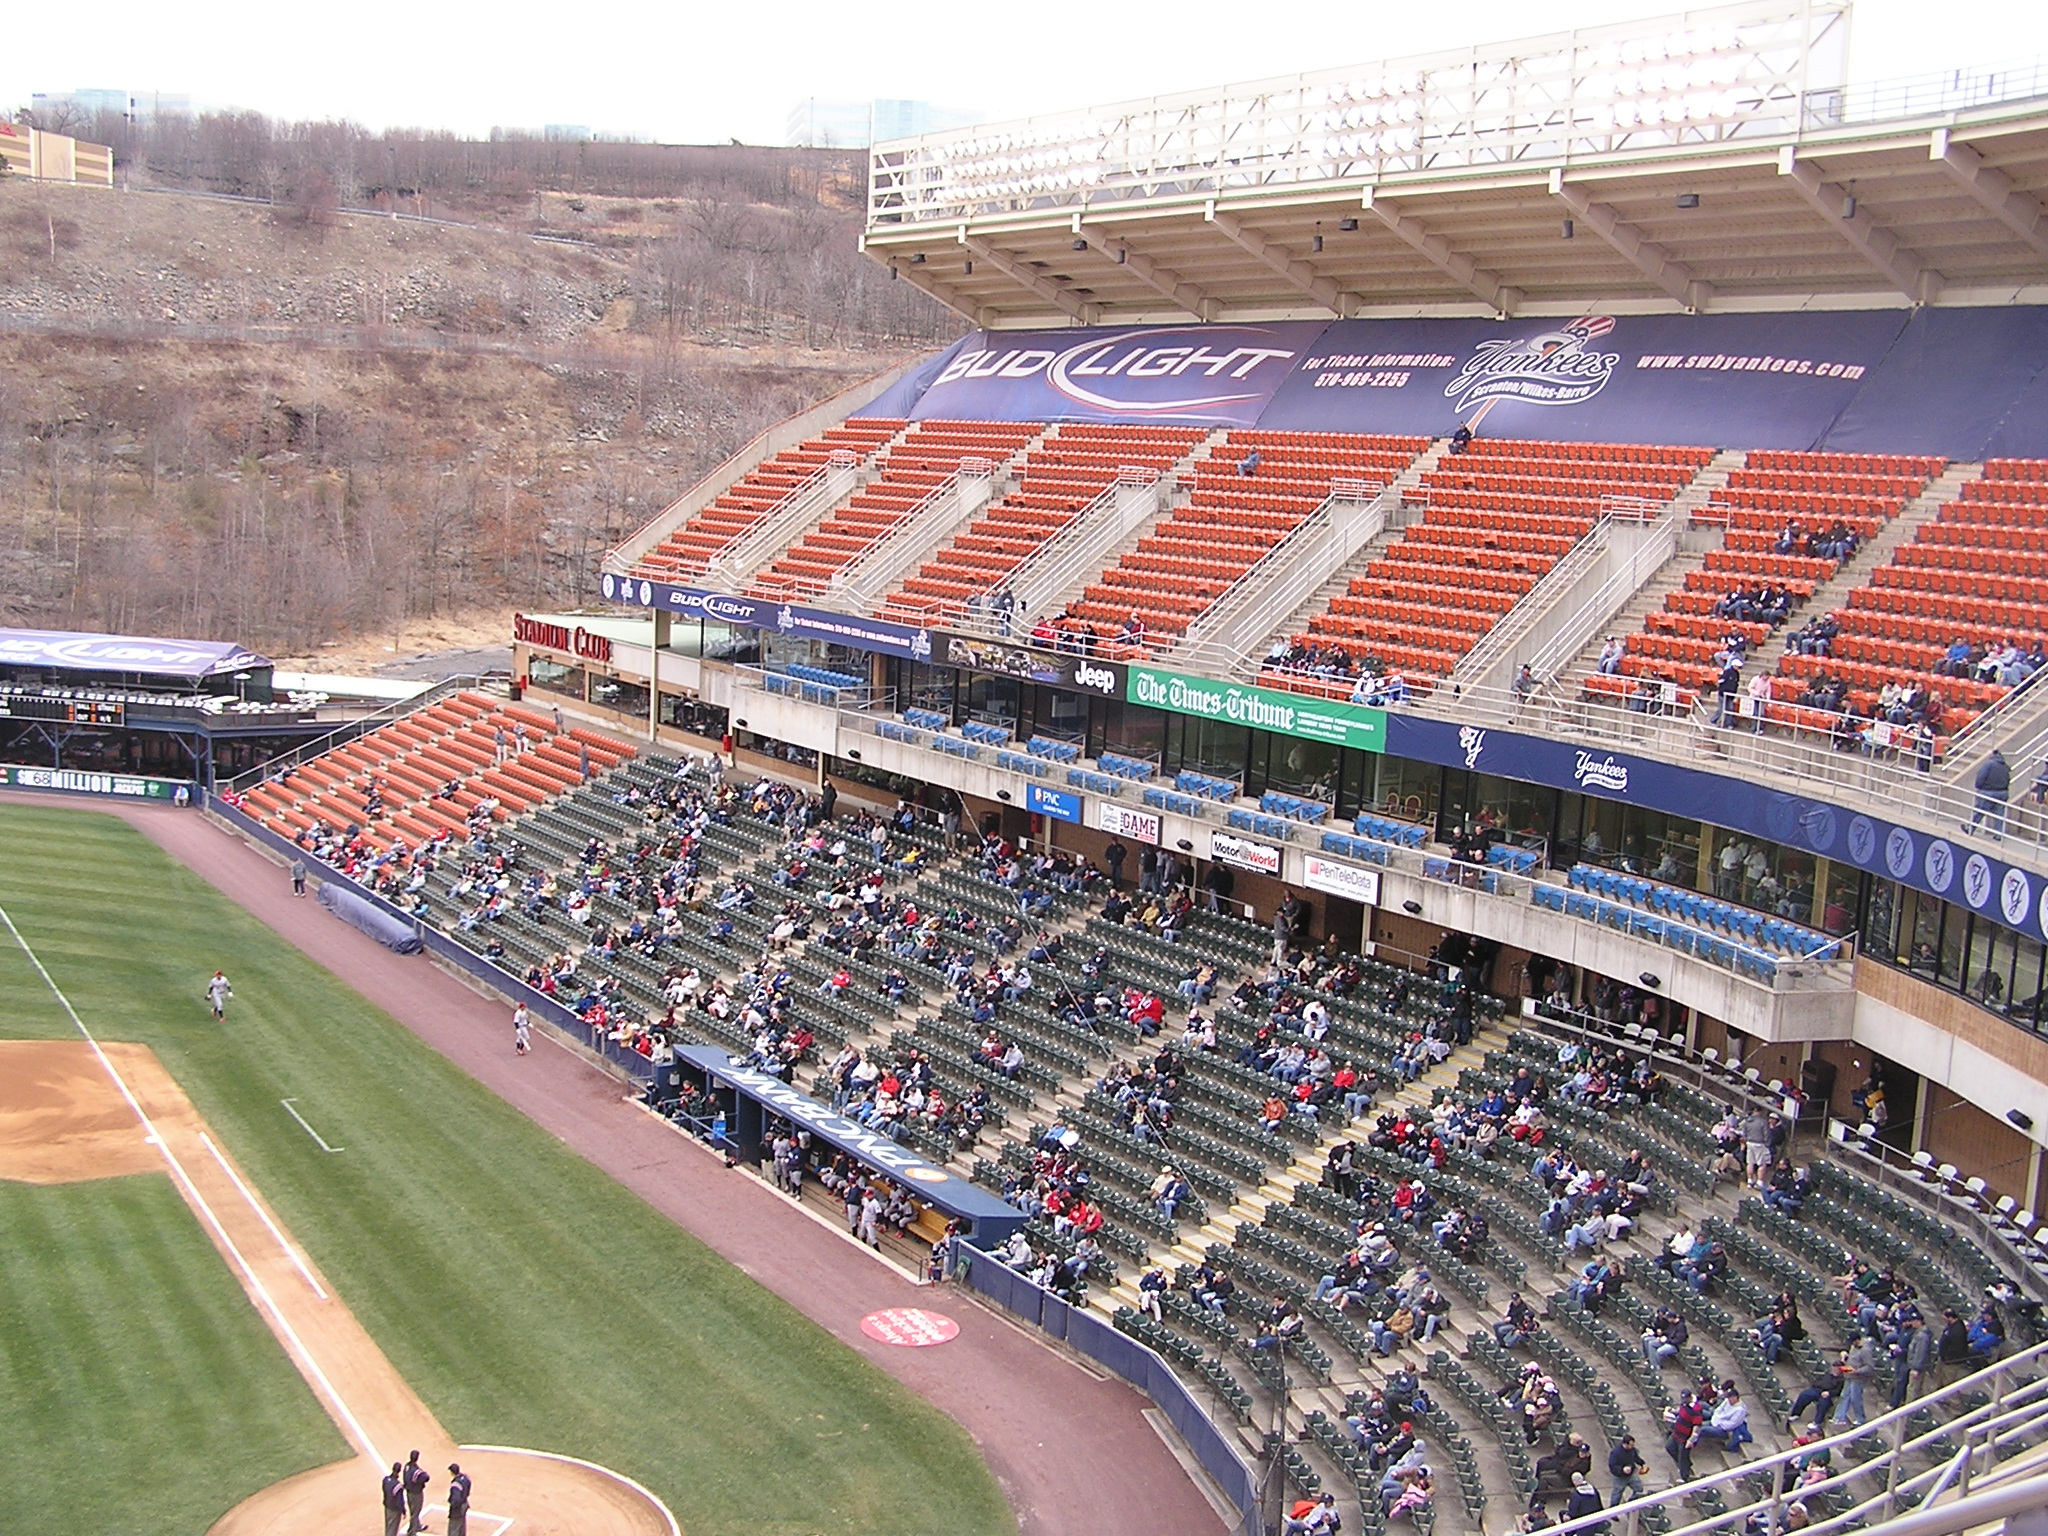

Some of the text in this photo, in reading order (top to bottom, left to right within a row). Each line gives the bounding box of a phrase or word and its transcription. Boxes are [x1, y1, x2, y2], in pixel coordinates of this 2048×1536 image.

[932, 346, 1295, 386] BUD LIGHT
[1301, 353, 1456, 370] For Ticket Information:
[1444, 337, 1620, 397] Yankees
[1636, 354, 1865, 380] www.swbyankees.com
[1313, 371, 1411, 388] 570-969-2255
[669, 591, 755, 617] BUD LIGHT
[513, 612, 611, 662] STADIUM CLUB
[71, 643, 216, 664] LIGHT
[1075, 661, 1115, 693] Jeep
[1136, 671, 1295, 730] The Times-Tribune
[1574, 750, 1628, 779] Yankees
[51, 771, 112, 793] MILLION
[1042, 790, 1060, 806] PNC
[1123, 812, 1156, 837] GAME
[1214, 840, 1240, 857] Motor
[1248, 850, 1276, 868] World
[1319, 862, 1371, 889] PenTeleData
[816, 1119, 923, 1168] PNC
